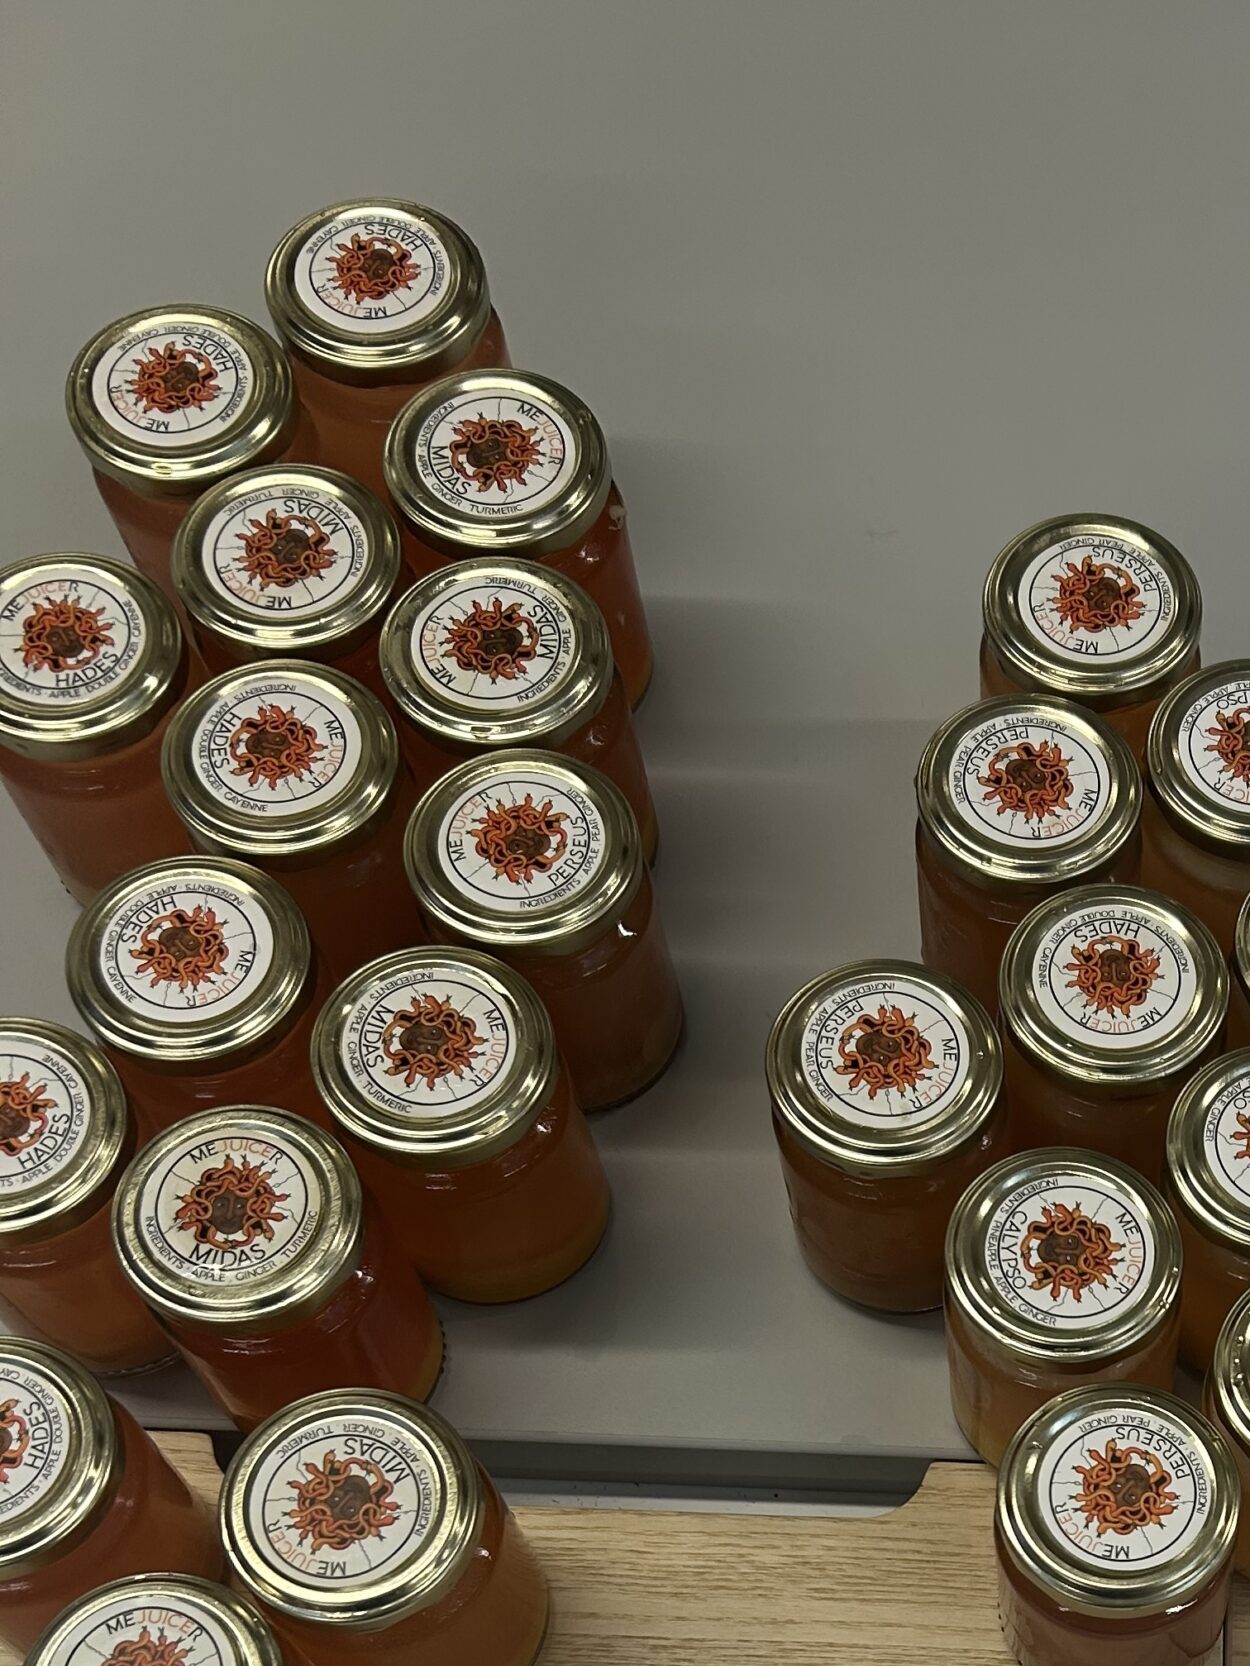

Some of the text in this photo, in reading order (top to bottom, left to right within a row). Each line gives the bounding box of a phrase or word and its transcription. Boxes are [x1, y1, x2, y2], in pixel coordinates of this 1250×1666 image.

[364, 223, 424, 253] HADES
[182, 333, 233, 373] HADES
[516, 401, 564, 466] MEJUICER
[432, 444, 471, 496] MIDAS
[283, 497, 343, 535] MIDAS
[469, 502, 523, 517] TURMERIC
[1092, 545, 1157, 593] PERSEUS
[2, 580, 79, 622] MEJUICER
[527, 603, 563, 663] MIDAS
[54, 652, 120, 688] HADES
[210, 711, 242, 771] HADES
[965, 726, 1030, 777] PERSEUS
[447, 791, 492, 862] MEJUICER
[1030, 787, 1094, 840] MEJUICER
[546, 815, 586, 885] PERSEUS
[119, 895, 177, 946] HADES
[1074, 921, 1140, 943] HADES
[361, 1005, 395, 1069] MIDAS
[816, 1000, 865, 1072] PERSEUS
[17, 1111, 72, 1170] HADES
[189, 1140, 284, 1168] MEJUICER
[188, 1242, 267, 1273] MIDAS
[1000, 1209, 1029, 1290] CALYPSO
[24, 1399, 54, 1471] HADES
[343, 1436, 411, 1484] MIDAS
[1115, 1425, 1191, 1479] PERSEUS
[270, 1518, 347, 1576] MEJUICER
[1052, 1502, 1130, 1559] MEJUICER
[105, 1609, 205, 1641] MEJUICER
